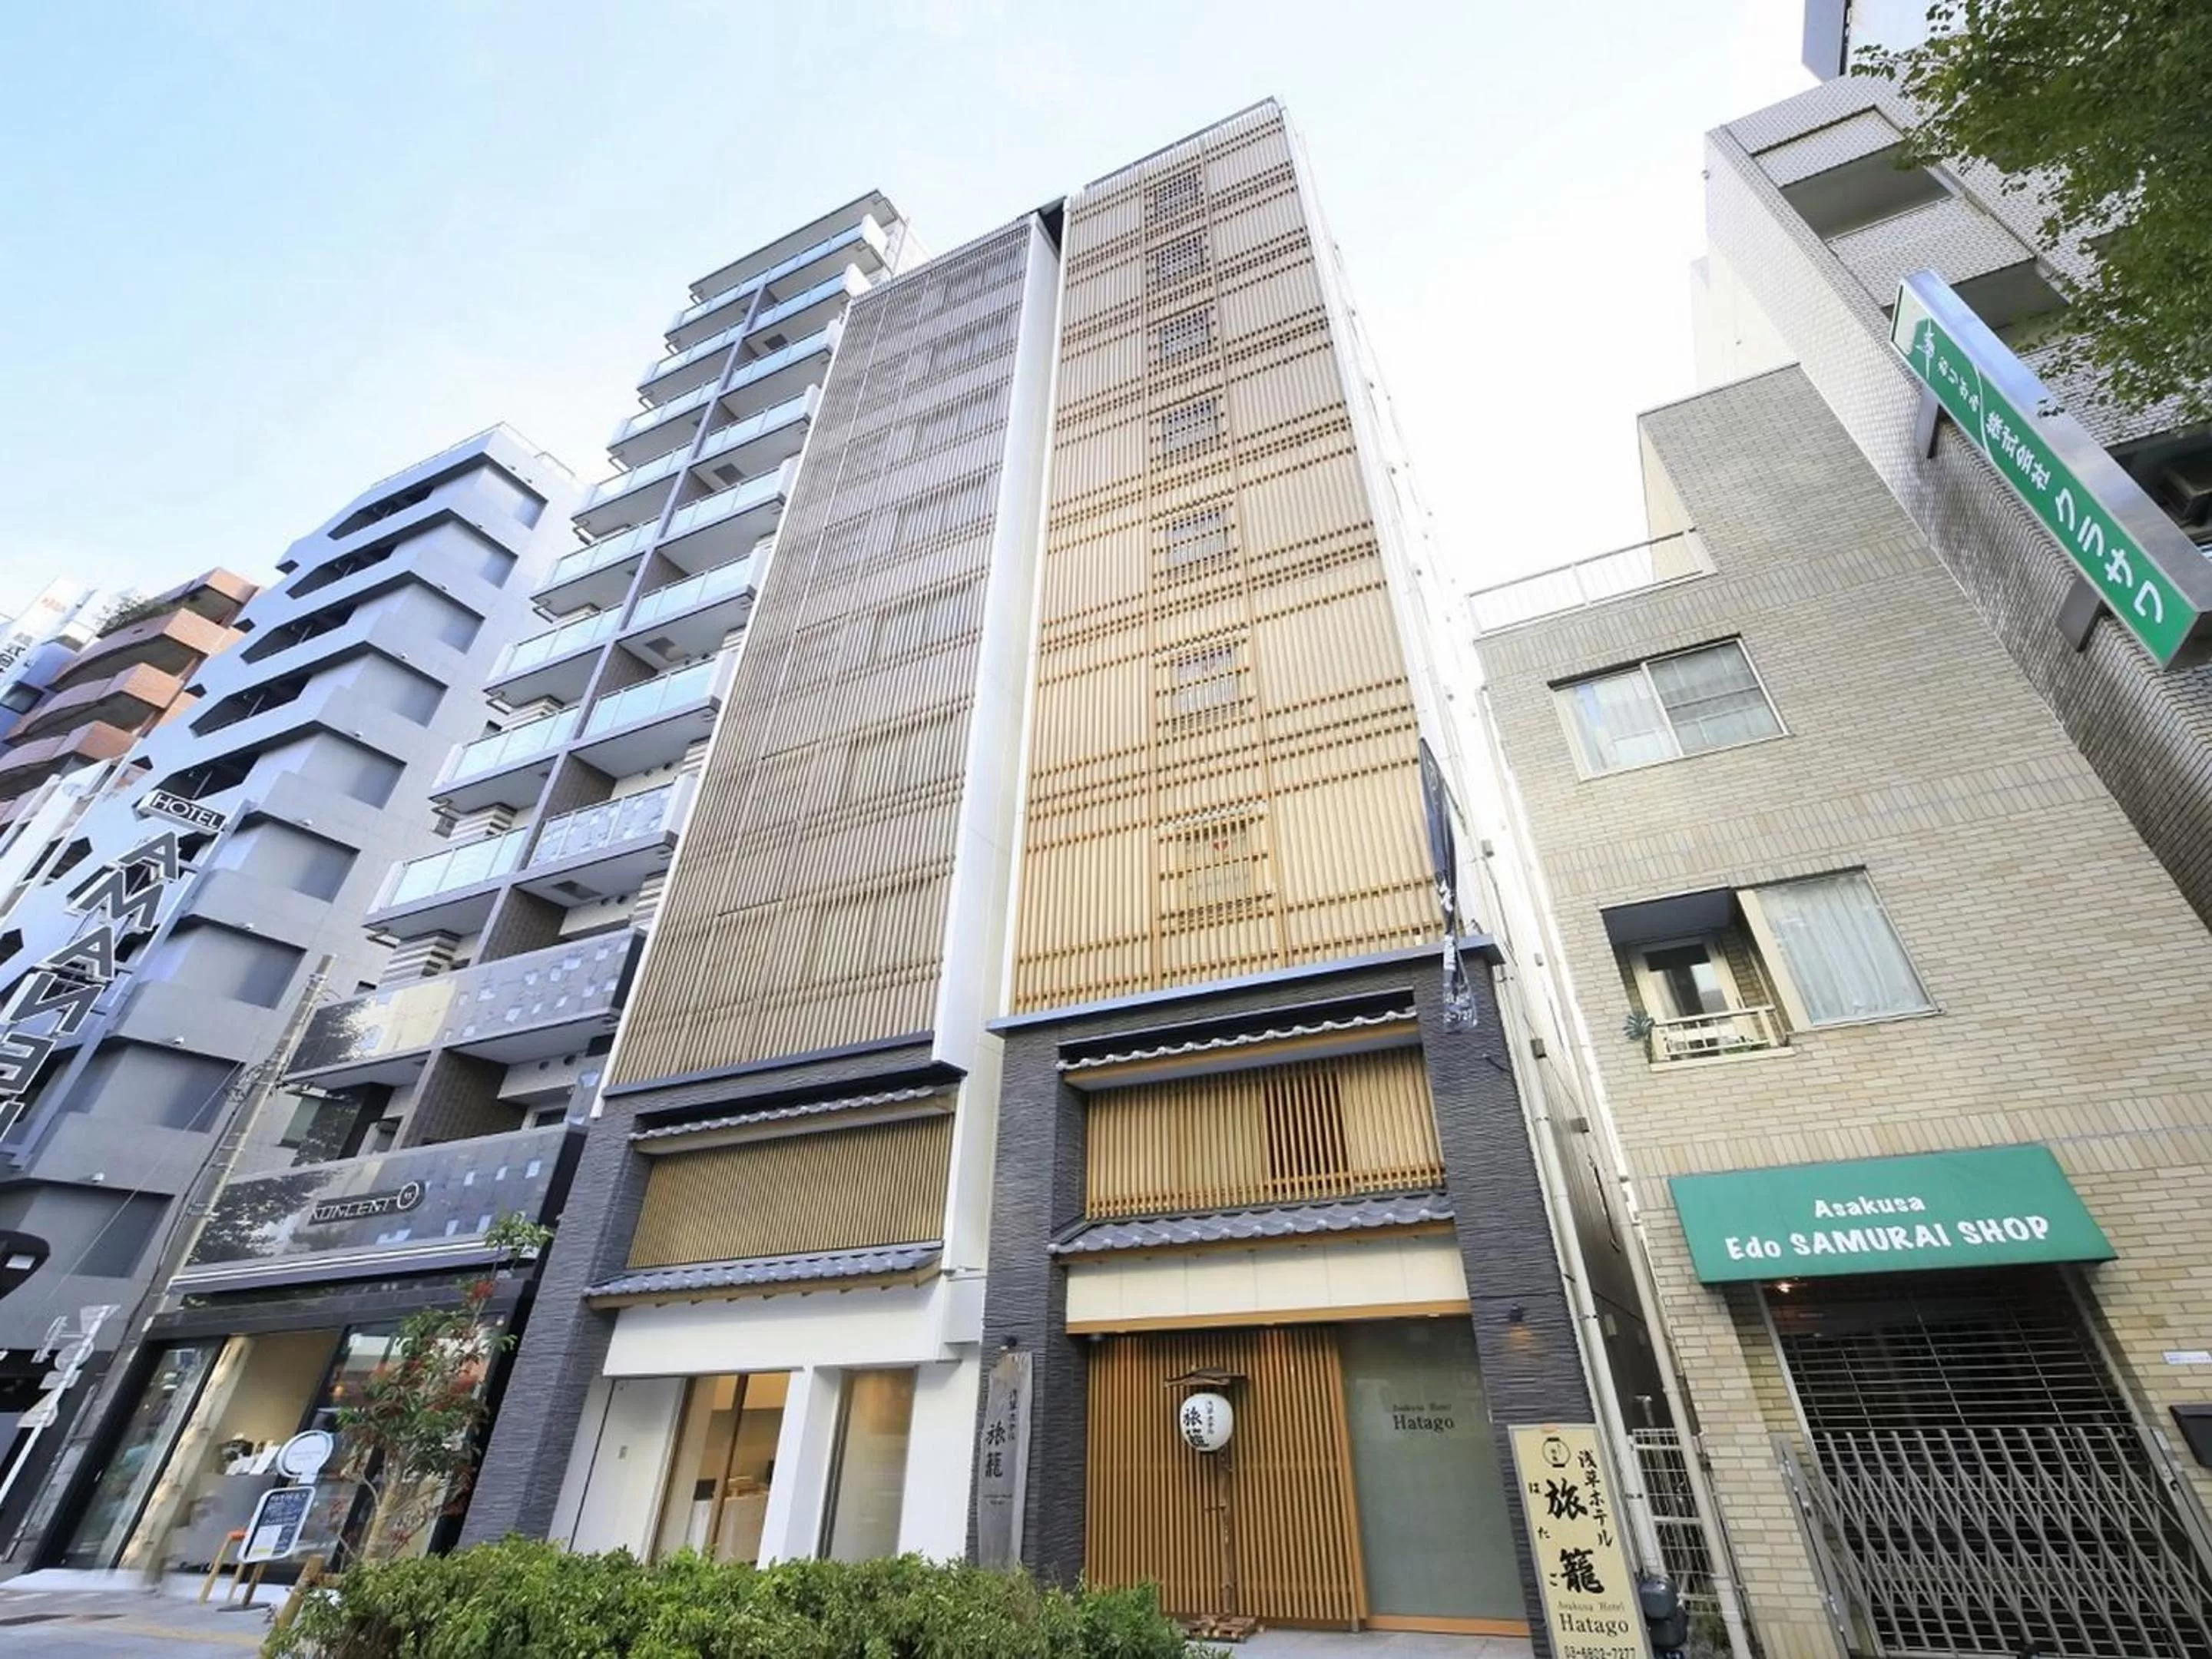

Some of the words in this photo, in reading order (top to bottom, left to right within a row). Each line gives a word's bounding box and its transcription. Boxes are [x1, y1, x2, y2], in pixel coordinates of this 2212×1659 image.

[1985, 411, 2051, 491] 株式会社
[2055, 488, 2164, 624] クラサワ
[153, 794, 218, 829] HOTEL
[1814, 1195, 1926, 1219] Asakusa
[1725, 1236, 1782, 1260] Edo
[1790, 1223, 1952, 1256] SAMURAI
[1957, 1215, 2050, 1246] SHOP
[1393, 1413, 1455, 1434] Hatago
[1578, 1449, 1613, 1548] 浅草ホテル
[1545, 1477, 1604, 1594] 旅籠
[1558, 1613, 1629, 1637] Hatago
